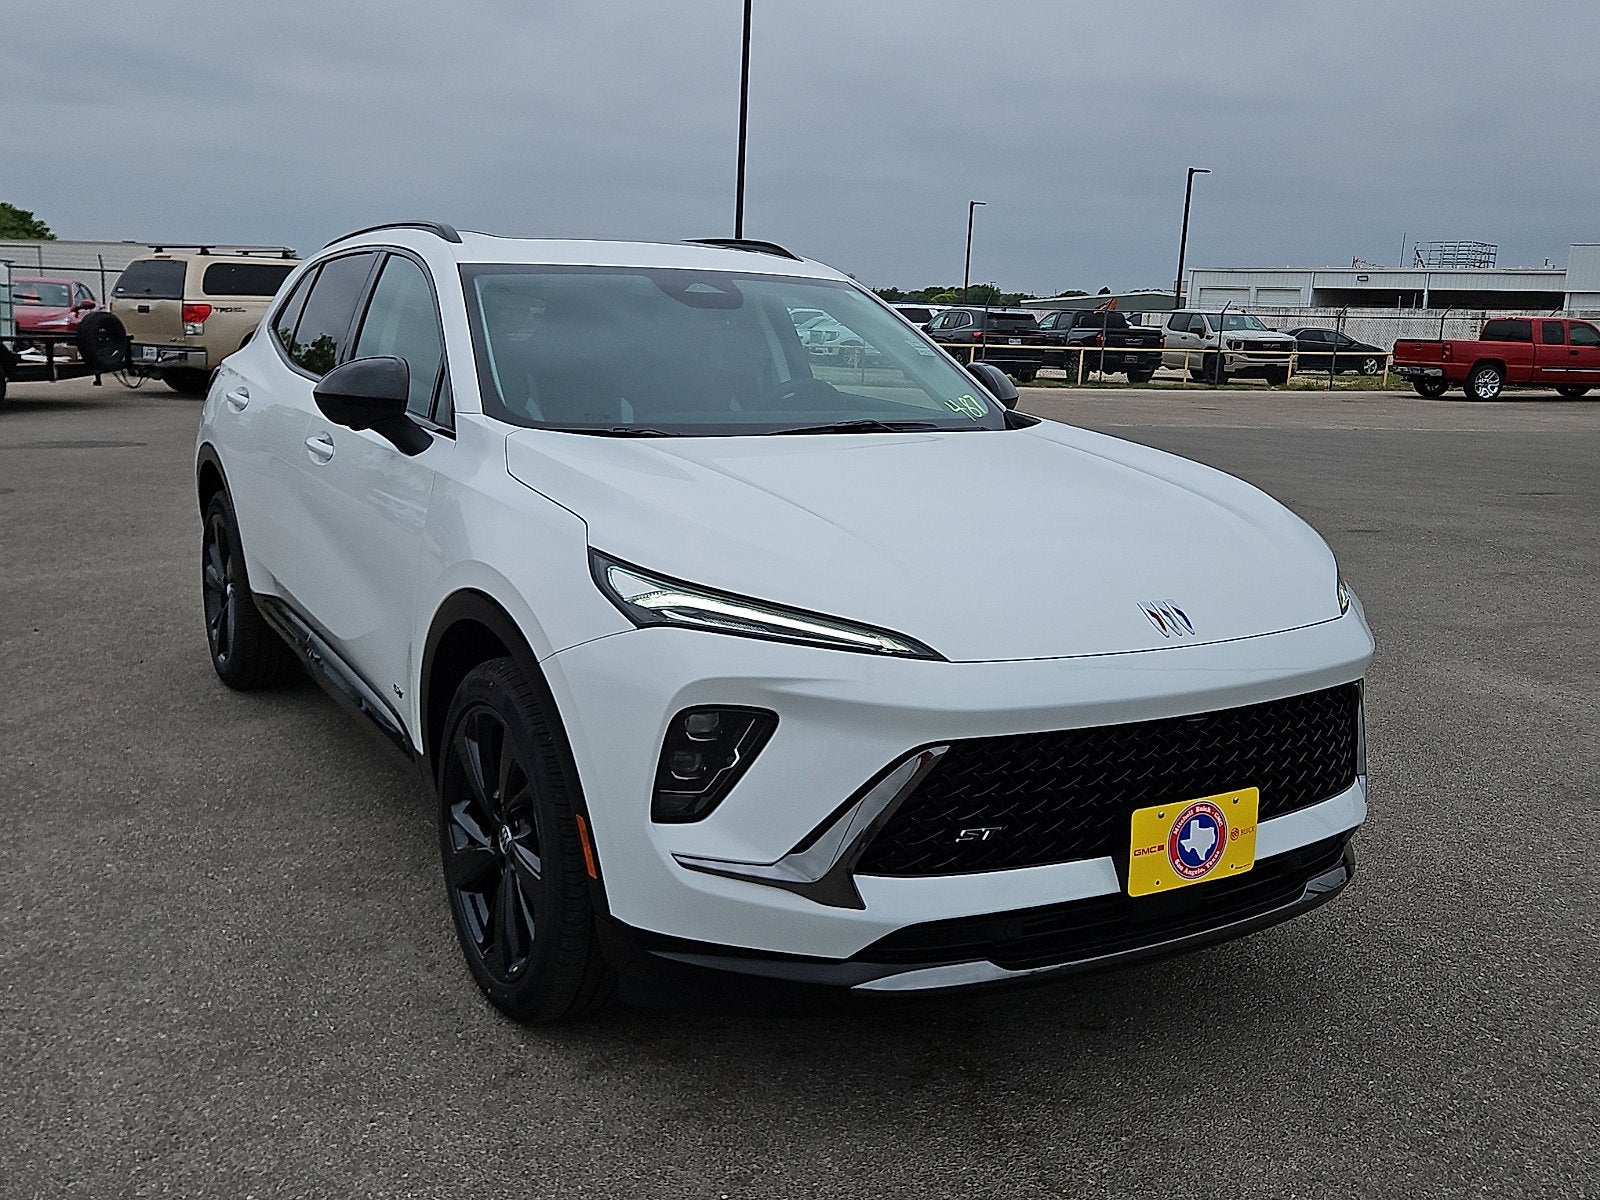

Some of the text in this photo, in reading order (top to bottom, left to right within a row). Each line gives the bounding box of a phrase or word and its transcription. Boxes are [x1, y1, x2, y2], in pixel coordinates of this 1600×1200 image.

[943, 394, 987, 422] 487
[1172, 809, 1194, 835] Mitchell
[1195, 804, 1212, 813] Buick
[1133, 846, 1157, 857] GMC
[1174, 858, 1184, 871] San
[1205, 850, 1220, 868] Texas
